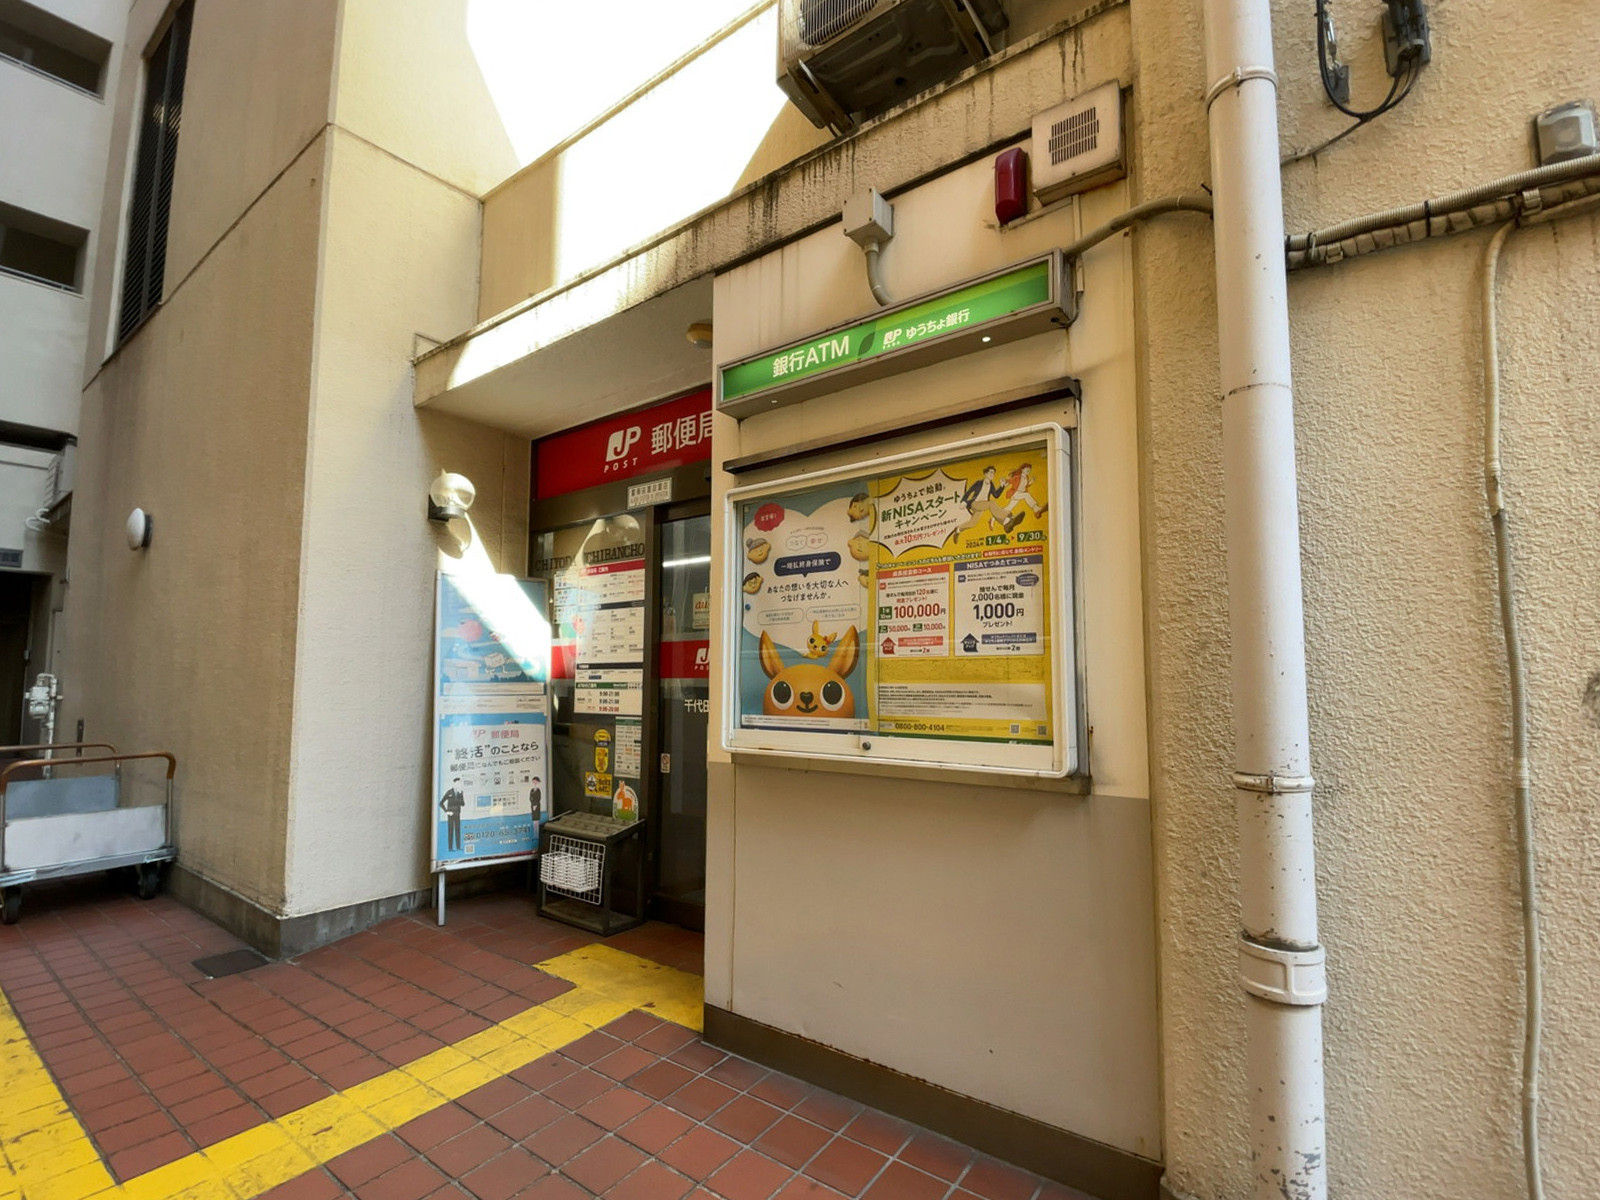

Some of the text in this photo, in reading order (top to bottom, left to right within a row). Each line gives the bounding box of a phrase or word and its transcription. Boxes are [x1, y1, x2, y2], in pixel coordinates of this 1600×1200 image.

[906, 308, 970, 339] ゆうちょ銀行
[772, 336, 850, 378] 銀行ATM
[606, 410, 712, 462] JP 郵便局
[604, 458, 638, 473] POST
[881, 491, 960, 522] 新NISAスタート
[895, 509, 947, 529] キャンペーン
[988, 536, 1002, 545] 1/4
[1019, 532, 1040, 541] 9/30
[781, 559, 831, 570] 一時払終身保険で
[767, 579, 849, 594] あなたの想いを大切な人へ
[980, 584, 1015, 592] 抽せんで毎月
[781, 592, 831, 602] つなげませんか。
[971, 593, 1024, 602] 2,000名様に現金
[894, 603, 946, 618] 100,000円
[973, 603, 1024, 621] 1,000円
[491, 730, 520, 739] 郵便局
[895, 723, 945, 731] 0800-800-4104
